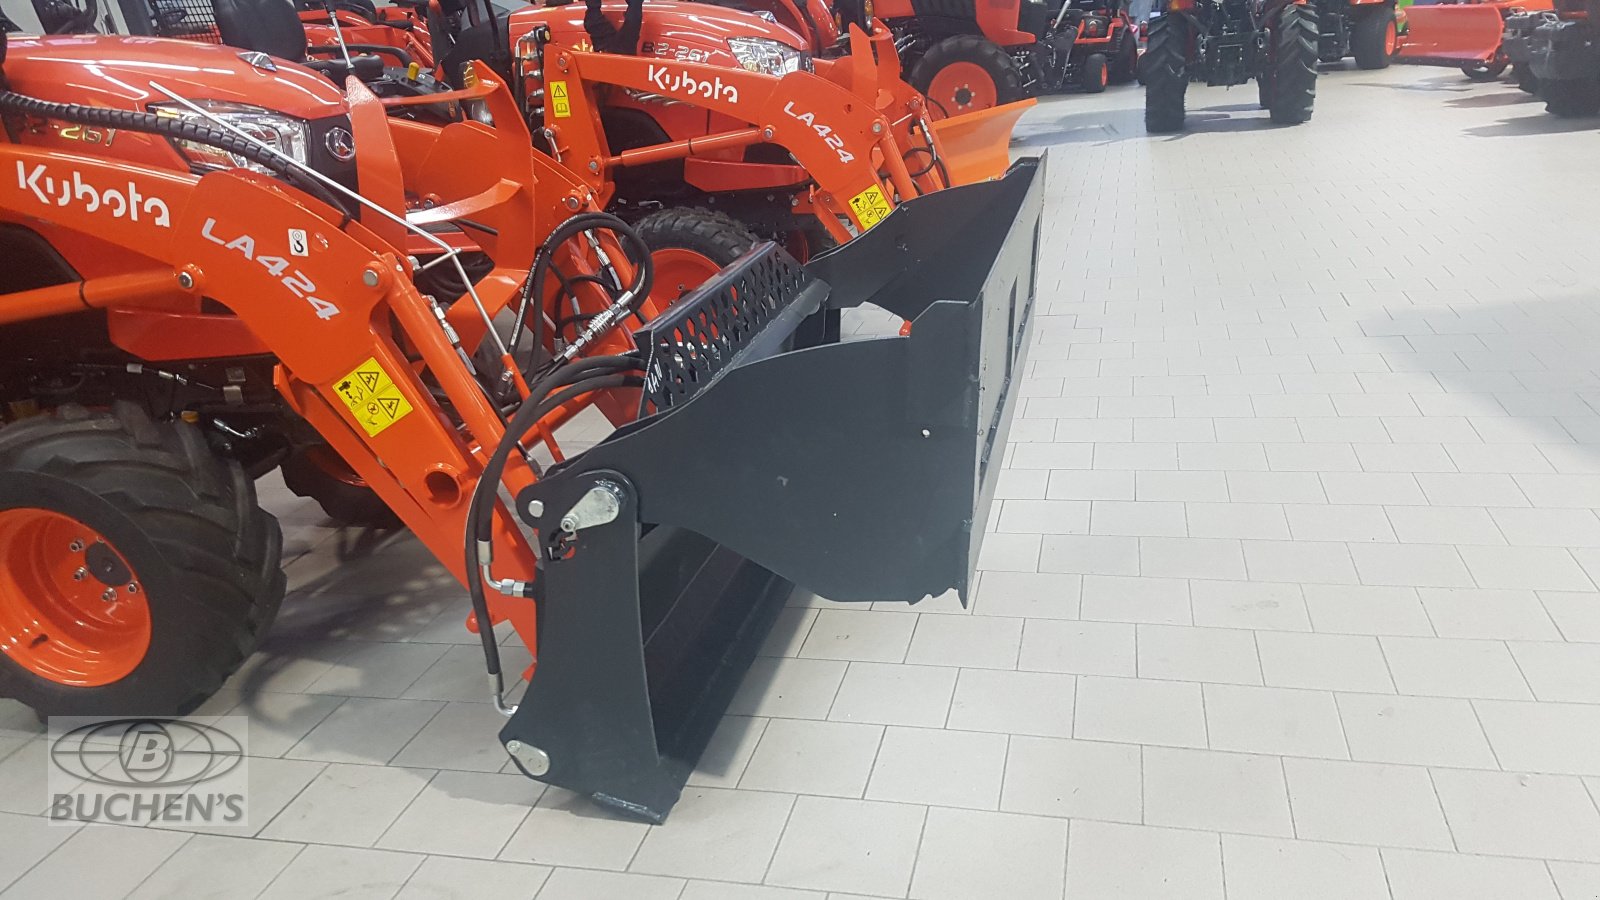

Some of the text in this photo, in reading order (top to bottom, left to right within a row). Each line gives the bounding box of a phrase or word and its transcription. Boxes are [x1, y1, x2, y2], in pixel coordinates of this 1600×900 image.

[648, 64, 739, 104] Kubota
[783, 100, 855, 164] LA424
[16, 160, 171, 228] Kubota
[201, 217, 341, 321] LA424
